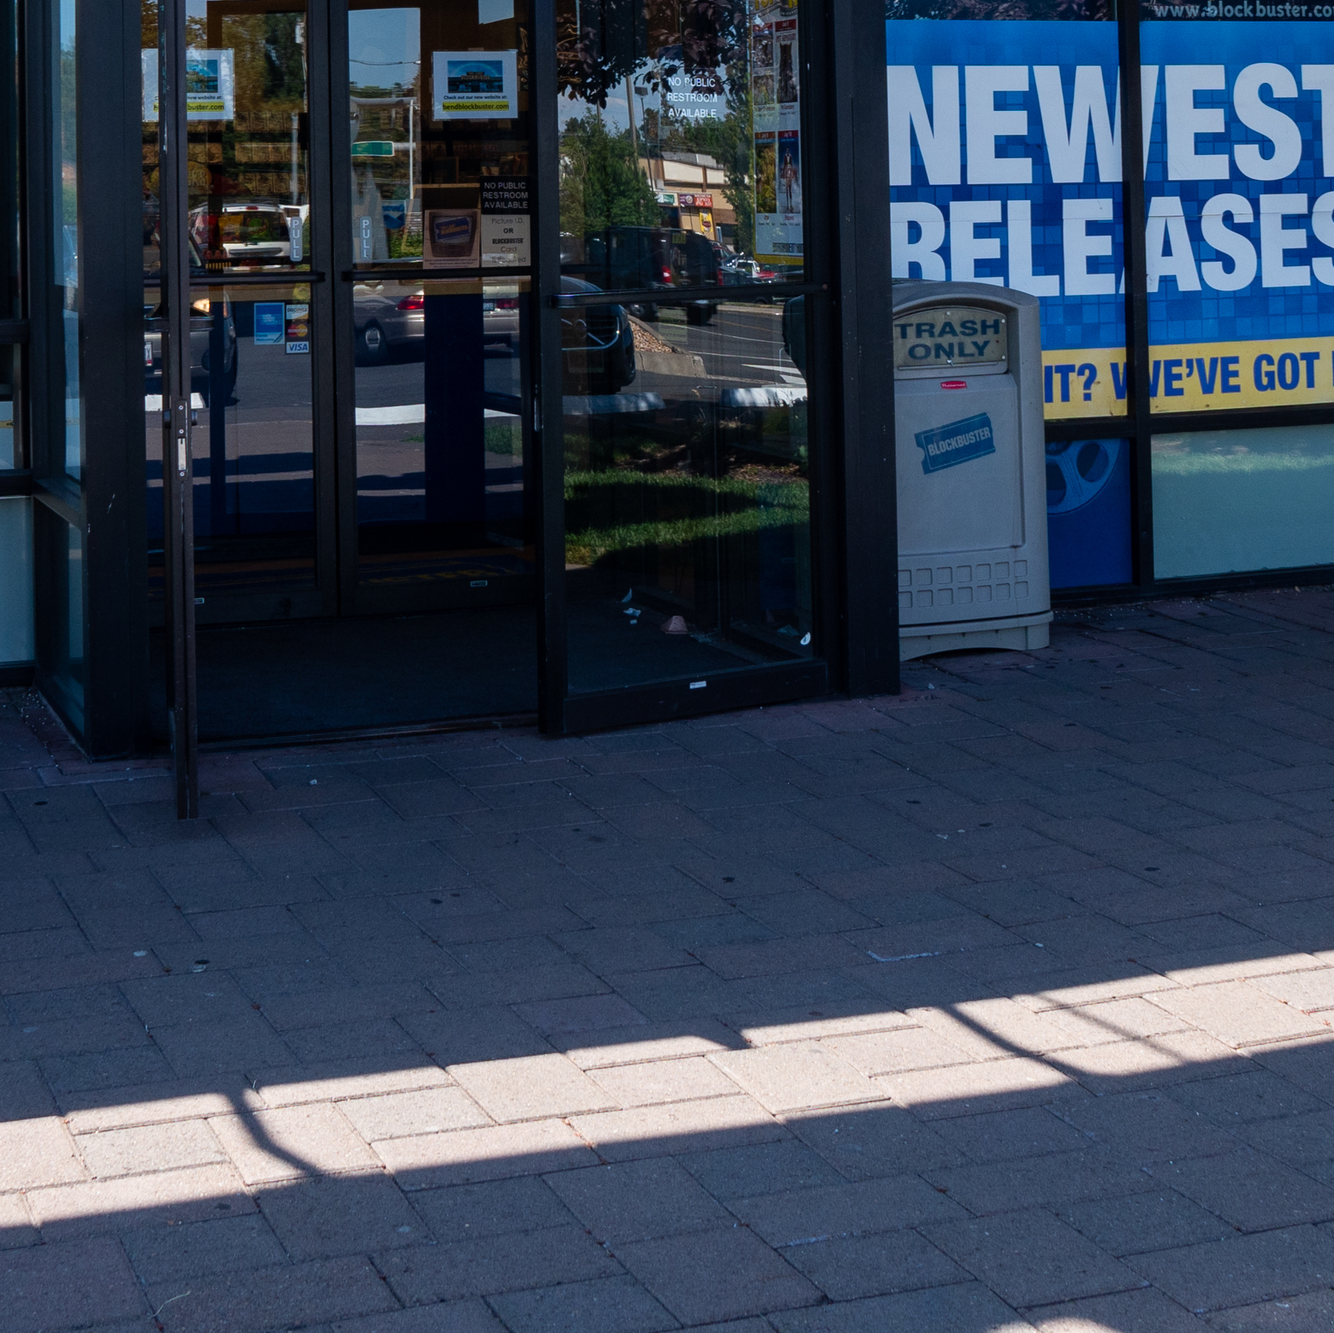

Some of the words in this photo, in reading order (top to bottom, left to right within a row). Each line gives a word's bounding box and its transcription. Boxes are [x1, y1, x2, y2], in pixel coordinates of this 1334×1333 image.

[668, 77, 681, 86] NO
[684, 77, 716, 87] PUBLIC
[667, 92, 718, 103] RESTROOM
[668, 108, 717, 117] AVAILABLE
[497, 181, 526, 189] PUBLIC
[483, 191, 528, 199] RESTROOM
[484, 201, 528, 209] AVAILABLE
[491, 217, 514, 225] Picture
[292, 219, 300, 258] PULL
[362, 219, 370, 259] PULL
[894, 318, 1000, 340] TRASH
[288, 343, 308, 351] VISA
[908, 340, 991, 361] ONLY
[1043, 362, 1098, 403] IT?
[1110, 355, 1241, 400] WE'VE
[1253, 350, 1320, 391] GOT
[927, 426, 991, 457] BLOCKBUSTER
